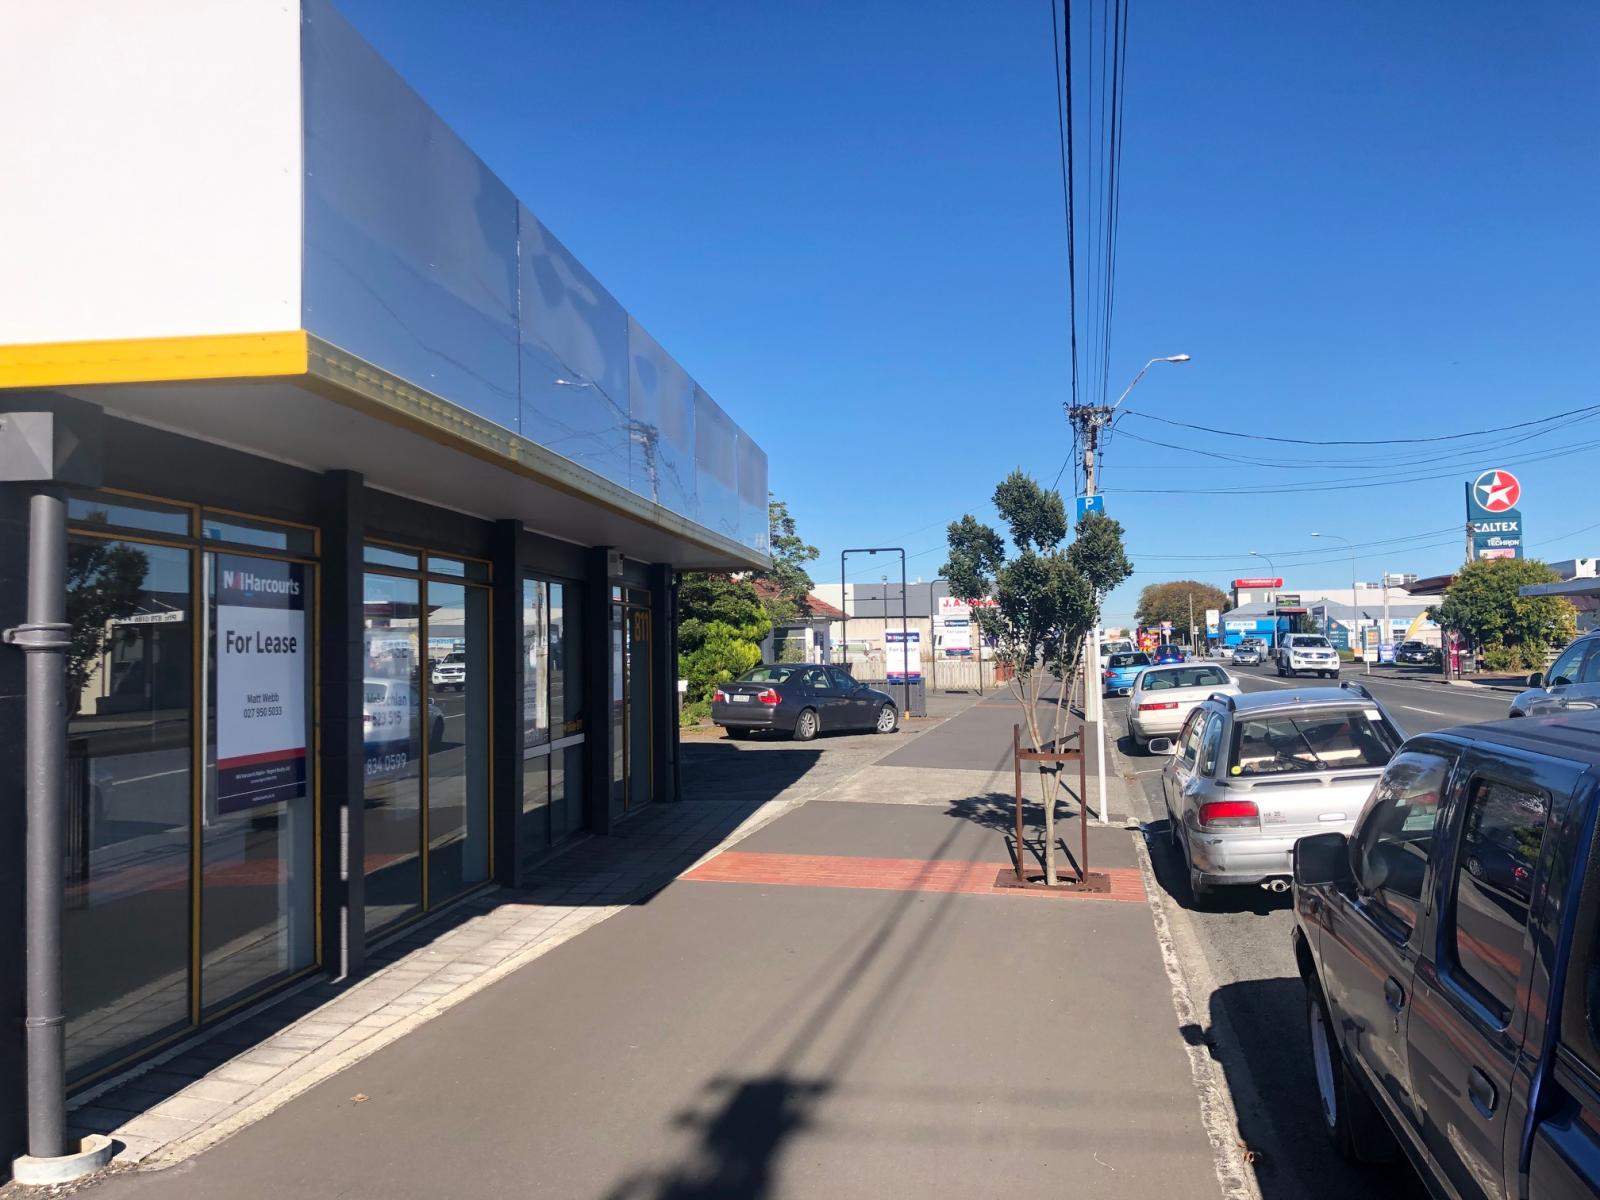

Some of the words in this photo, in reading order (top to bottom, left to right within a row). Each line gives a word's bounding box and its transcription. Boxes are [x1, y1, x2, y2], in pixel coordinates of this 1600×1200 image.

[1474, 522, 1518, 532] CALTEX
[634, 611, 648, 642] 811
[226, 630, 252, 654] For
[256, 630, 297, 654] Lease
[247, 694, 262, 704] Matt
[262, 692, 280, 702] Webb
[367, 758, 382, 776] 834
[384, 752, 407, 772] 0599
